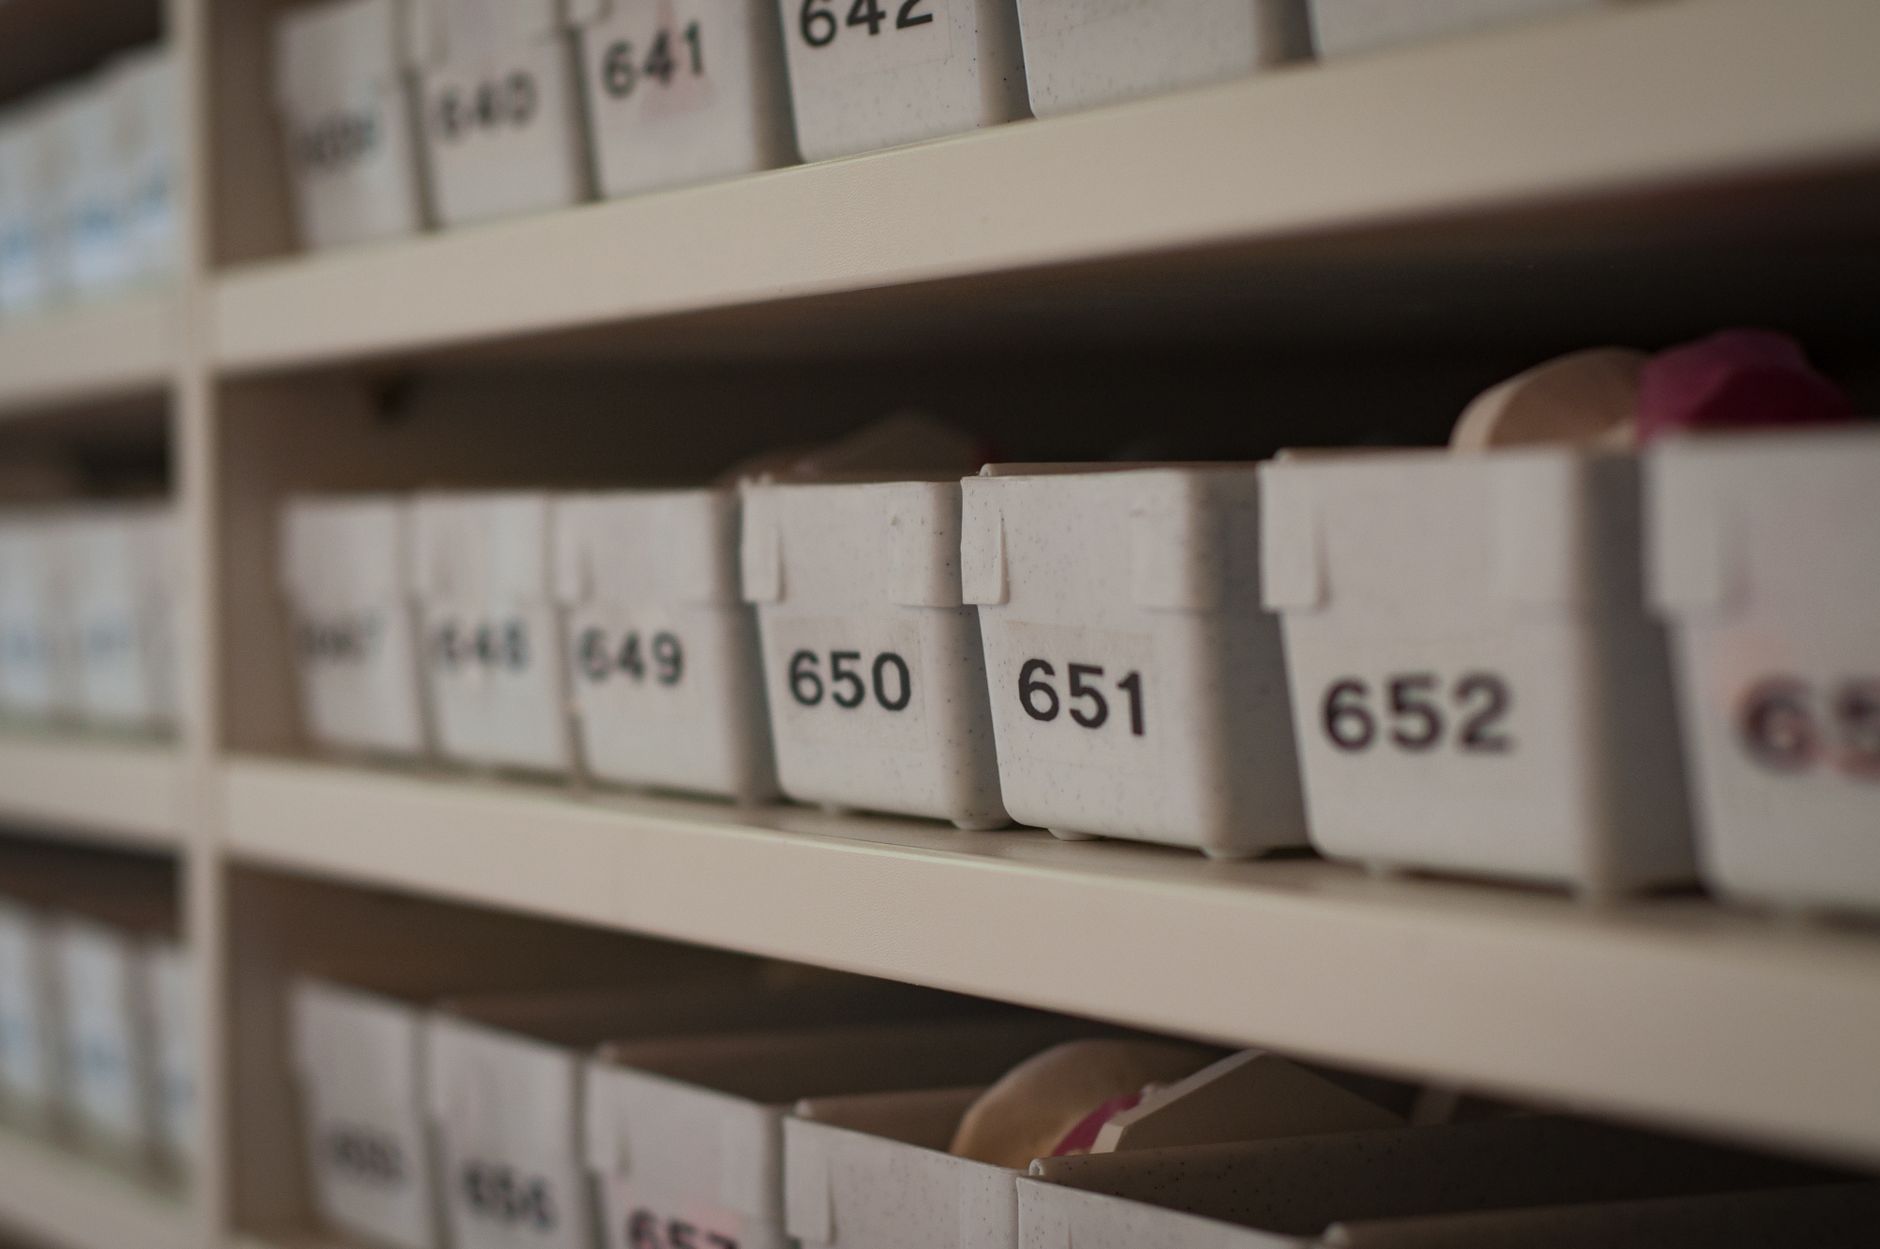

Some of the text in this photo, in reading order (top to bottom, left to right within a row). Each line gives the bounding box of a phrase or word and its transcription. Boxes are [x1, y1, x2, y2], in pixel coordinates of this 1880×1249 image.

[602, 21, 704, 101] 641
[578, 628, 684, 688] 649
[788, 649, 913, 712] 650
[1018, 657, 1146, 737] 651
[1322, 671, 1517, 755] 652
